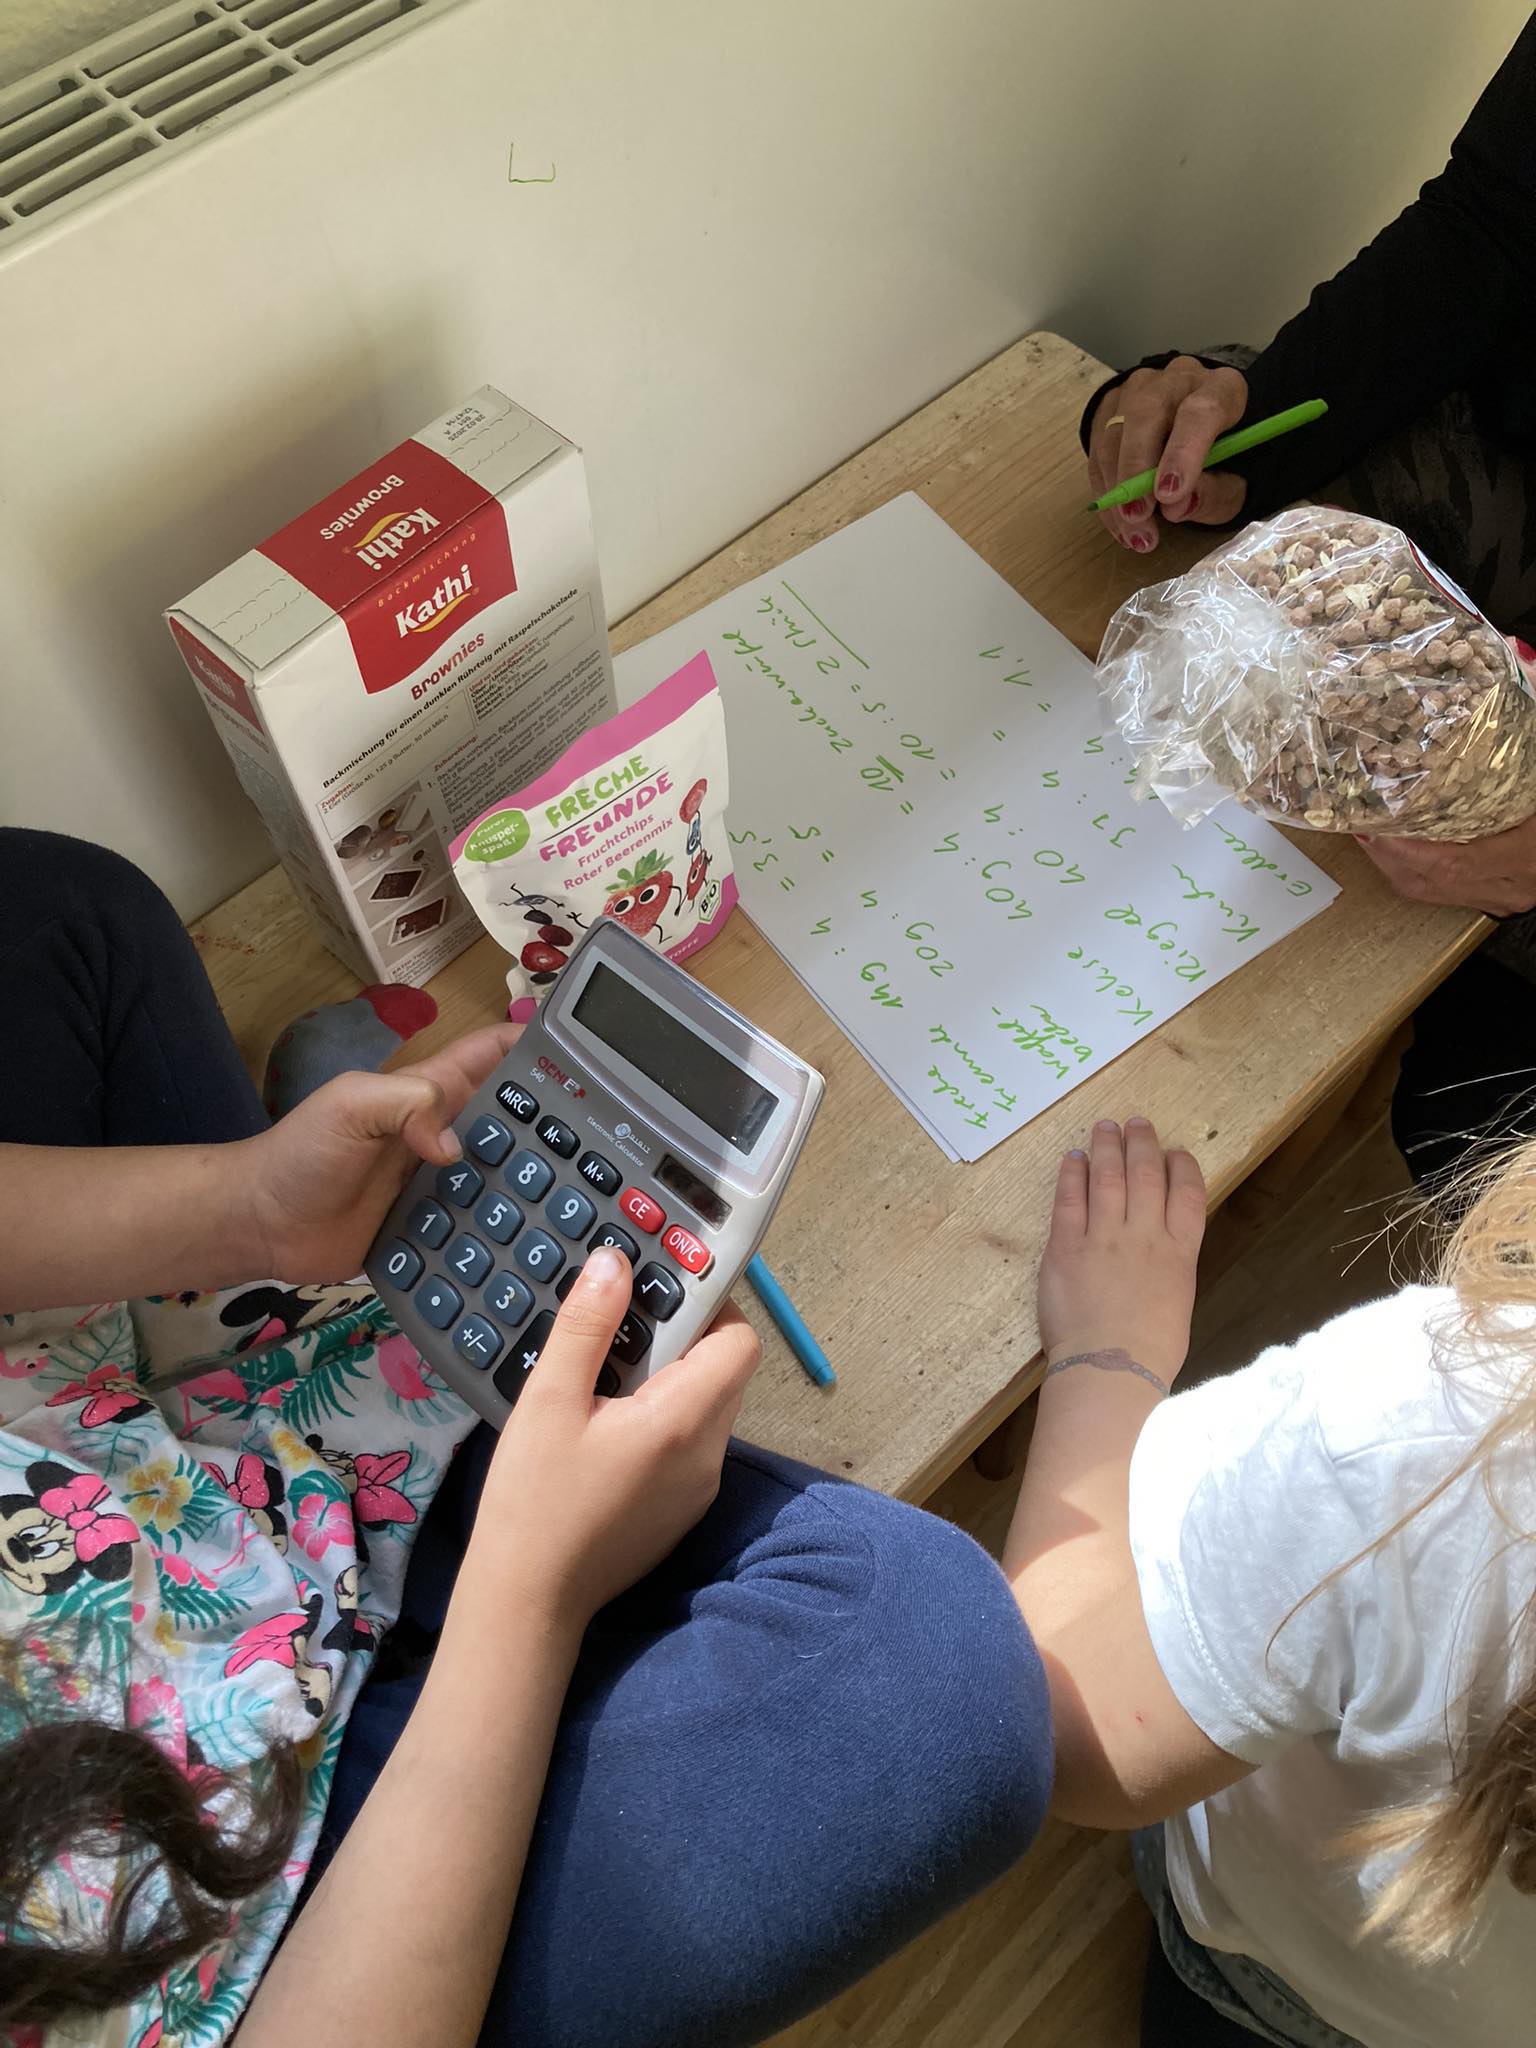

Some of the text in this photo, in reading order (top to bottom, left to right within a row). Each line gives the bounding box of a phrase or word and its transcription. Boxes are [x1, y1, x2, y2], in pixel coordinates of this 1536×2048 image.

[320, 474, 405, 540] Brownies
[356, 507, 441, 570] Kathi
[377, 532, 477, 608] Backmischung
[395, 564, 473, 638] Kathi
[323, 588, 577, 787] Backmischung für einen dunklen Rührteig mit Raspelschokolade
[411, 633, 485, 700] Brownies
[817, 656, 840, 674] 2
[900, 735, 935, 760] 10
[538, 771, 674, 862] FREUNDE
[545, 754, 650, 829] FRECHE
[469, 824, 519, 853] Knusper-
[562, 817, 675, 890] Roter Beerenmix
[577, 813, 654, 868] Fruchtchips
[788, 826, 820, 839] 5
[982, 861, 1032, 919] 40g
[1034, 850, 1085, 883] 40
[667, 938, 700, 960] TOFFE
[905, 922, 954, 977] 20g
[1105, 904, 1206, 982] Riegel
[1068, 947, 1153, 1026] Kekse
[530, 1067, 545, 1084] 540
[538, 1056, 577, 1091] GENIE
[928, 1065, 988, 1129] Freche
[929, 1024, 1016, 1112] Freunde
[477, 1124, 500, 1146] 7
[518, 1162, 538, 1185] 8
[560, 1199, 580, 1220] 9
[586, 1115, 645, 1168] Electronic Calculator
[500, 1086, 702, 1263] MRC M- M+ CE ON/C
[449, 1172, 469, 1192] 4
[487, 1203, 508, 1227] 5
[527, 1244, 547, 1265] 6
[388, 1252, 406, 1274] 0
[420, 1213, 437, 1234] 1
[455, 1247, 477, 1273] 2
[496, 1286, 516, 1310] 3
